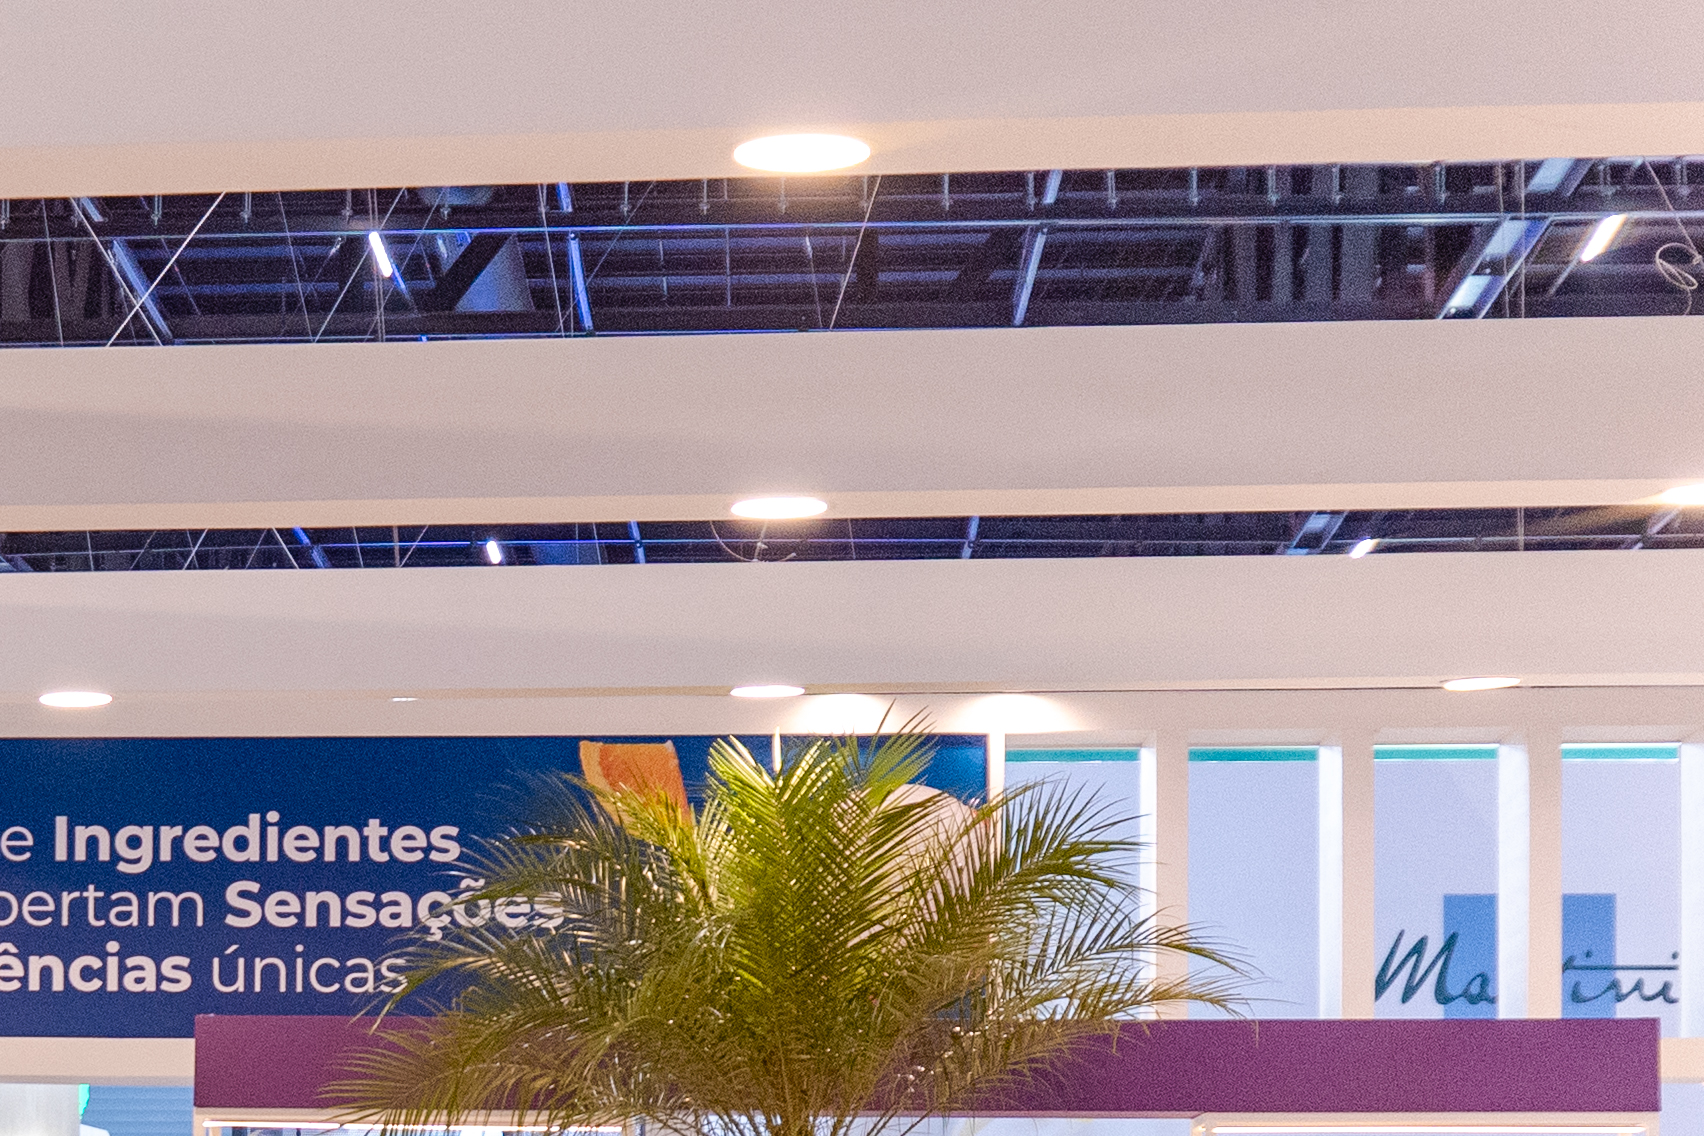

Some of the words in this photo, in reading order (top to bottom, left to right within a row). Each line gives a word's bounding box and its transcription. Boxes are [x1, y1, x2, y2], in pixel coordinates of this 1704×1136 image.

[0, 827, 34, 862] e
[55, 812, 460, 873] Ingredientes
[212, 944, 410, 994] únicas
[1374, 928, 1679, 1005] Maini
